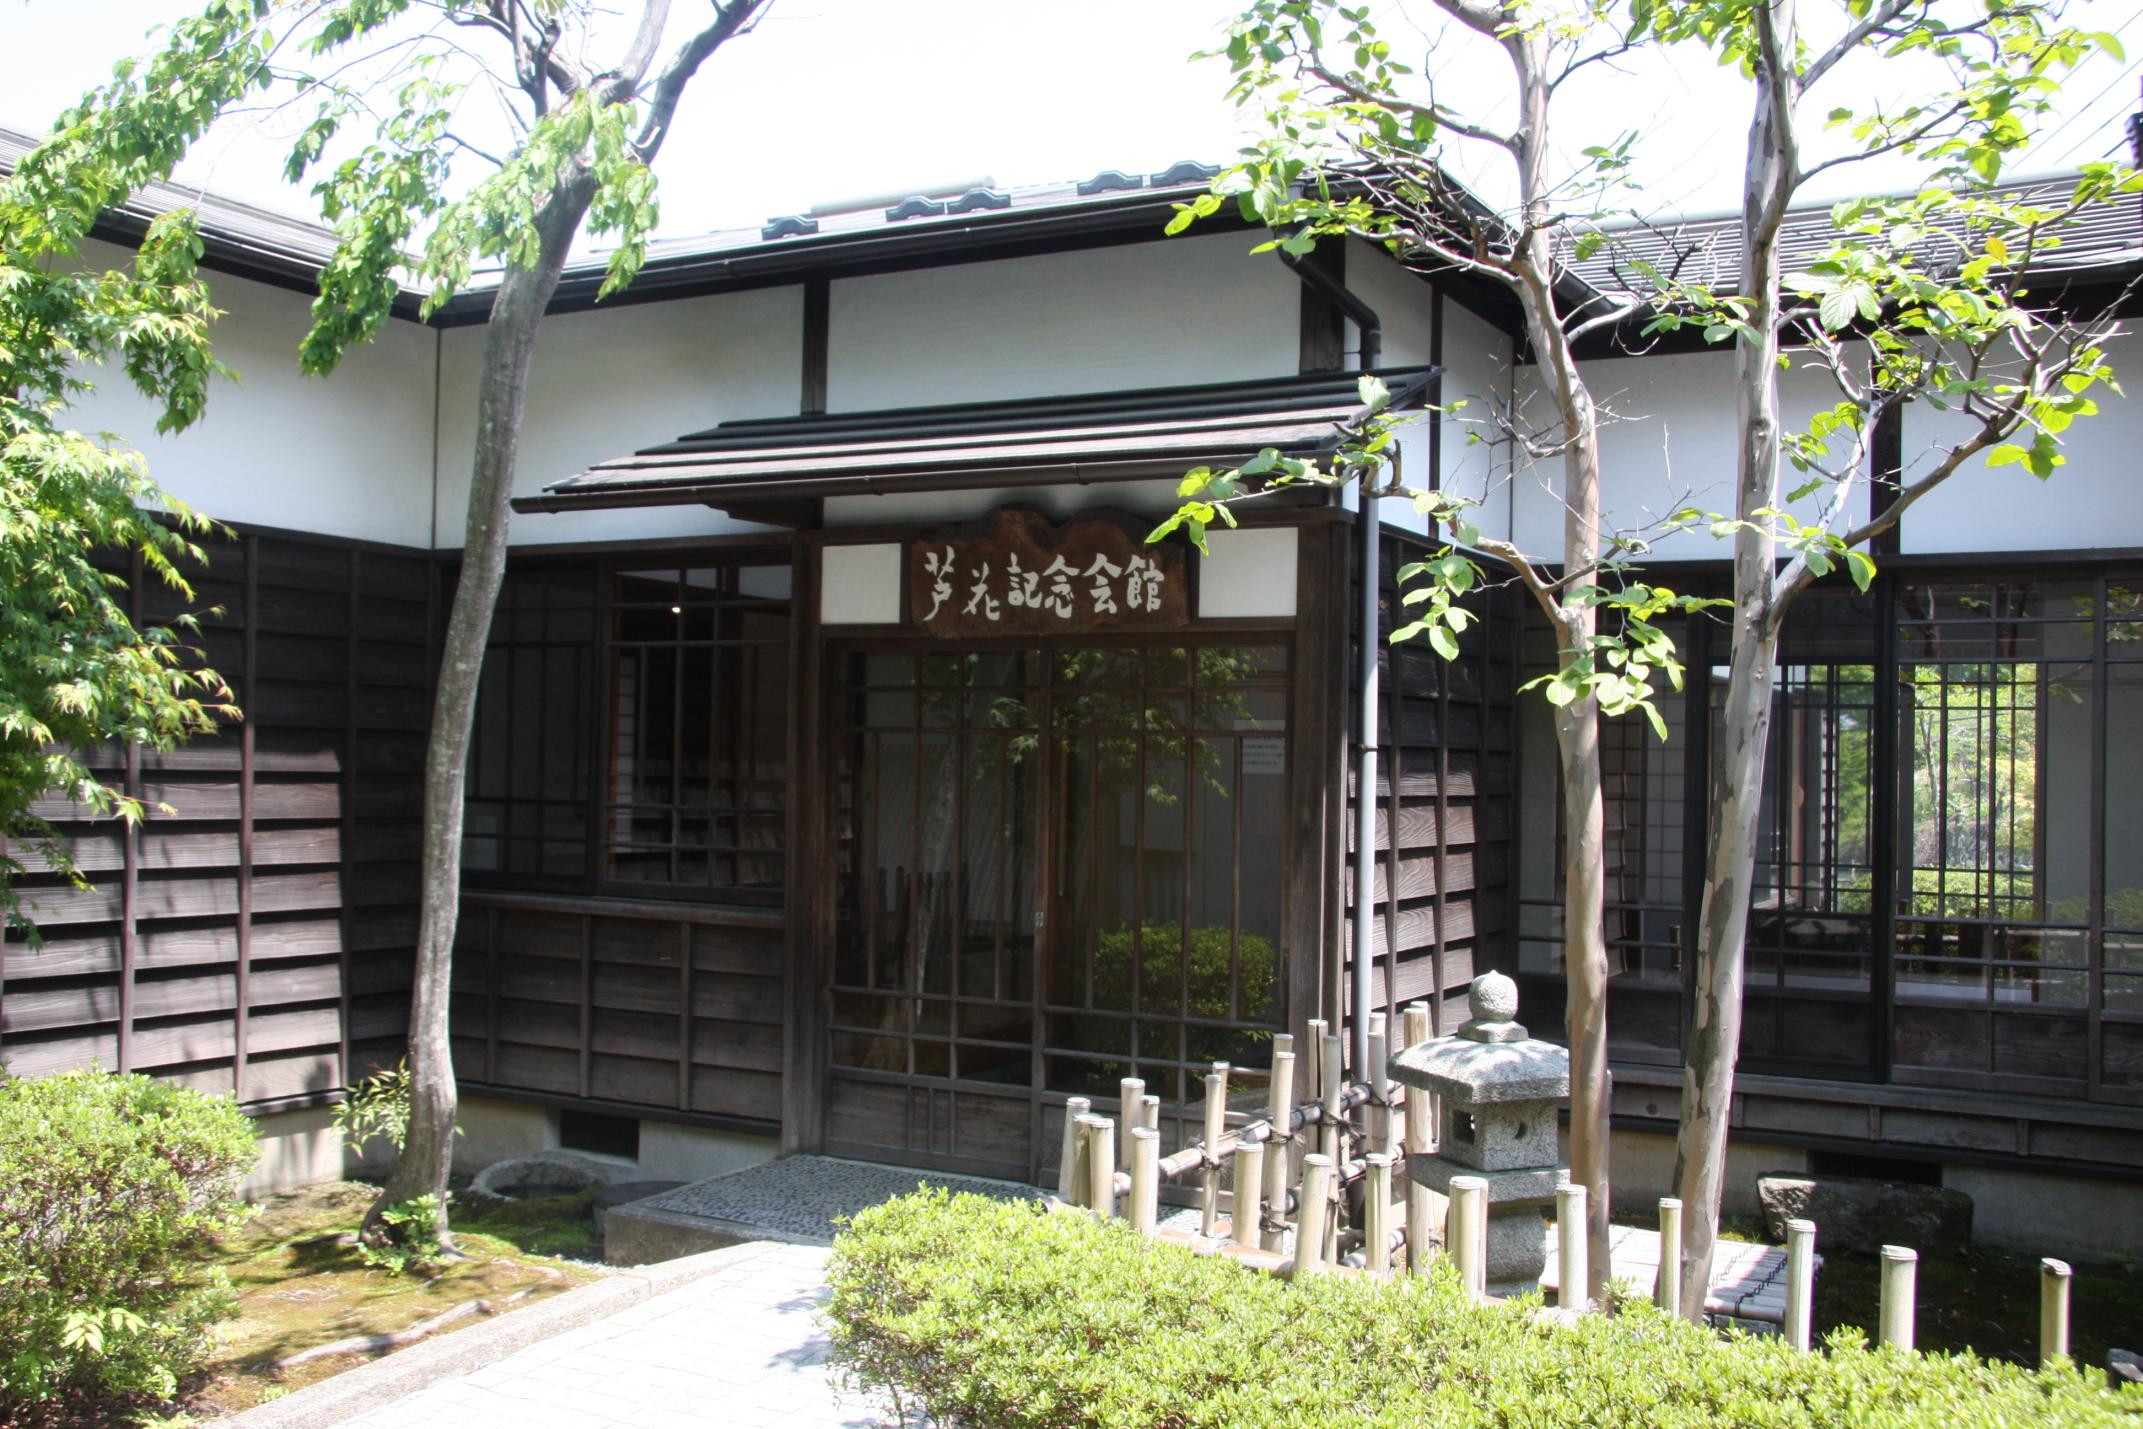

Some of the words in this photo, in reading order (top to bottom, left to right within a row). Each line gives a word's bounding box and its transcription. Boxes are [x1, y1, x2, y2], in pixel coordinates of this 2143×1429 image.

[922, 545, 1166, 622] 芦花記念会館
